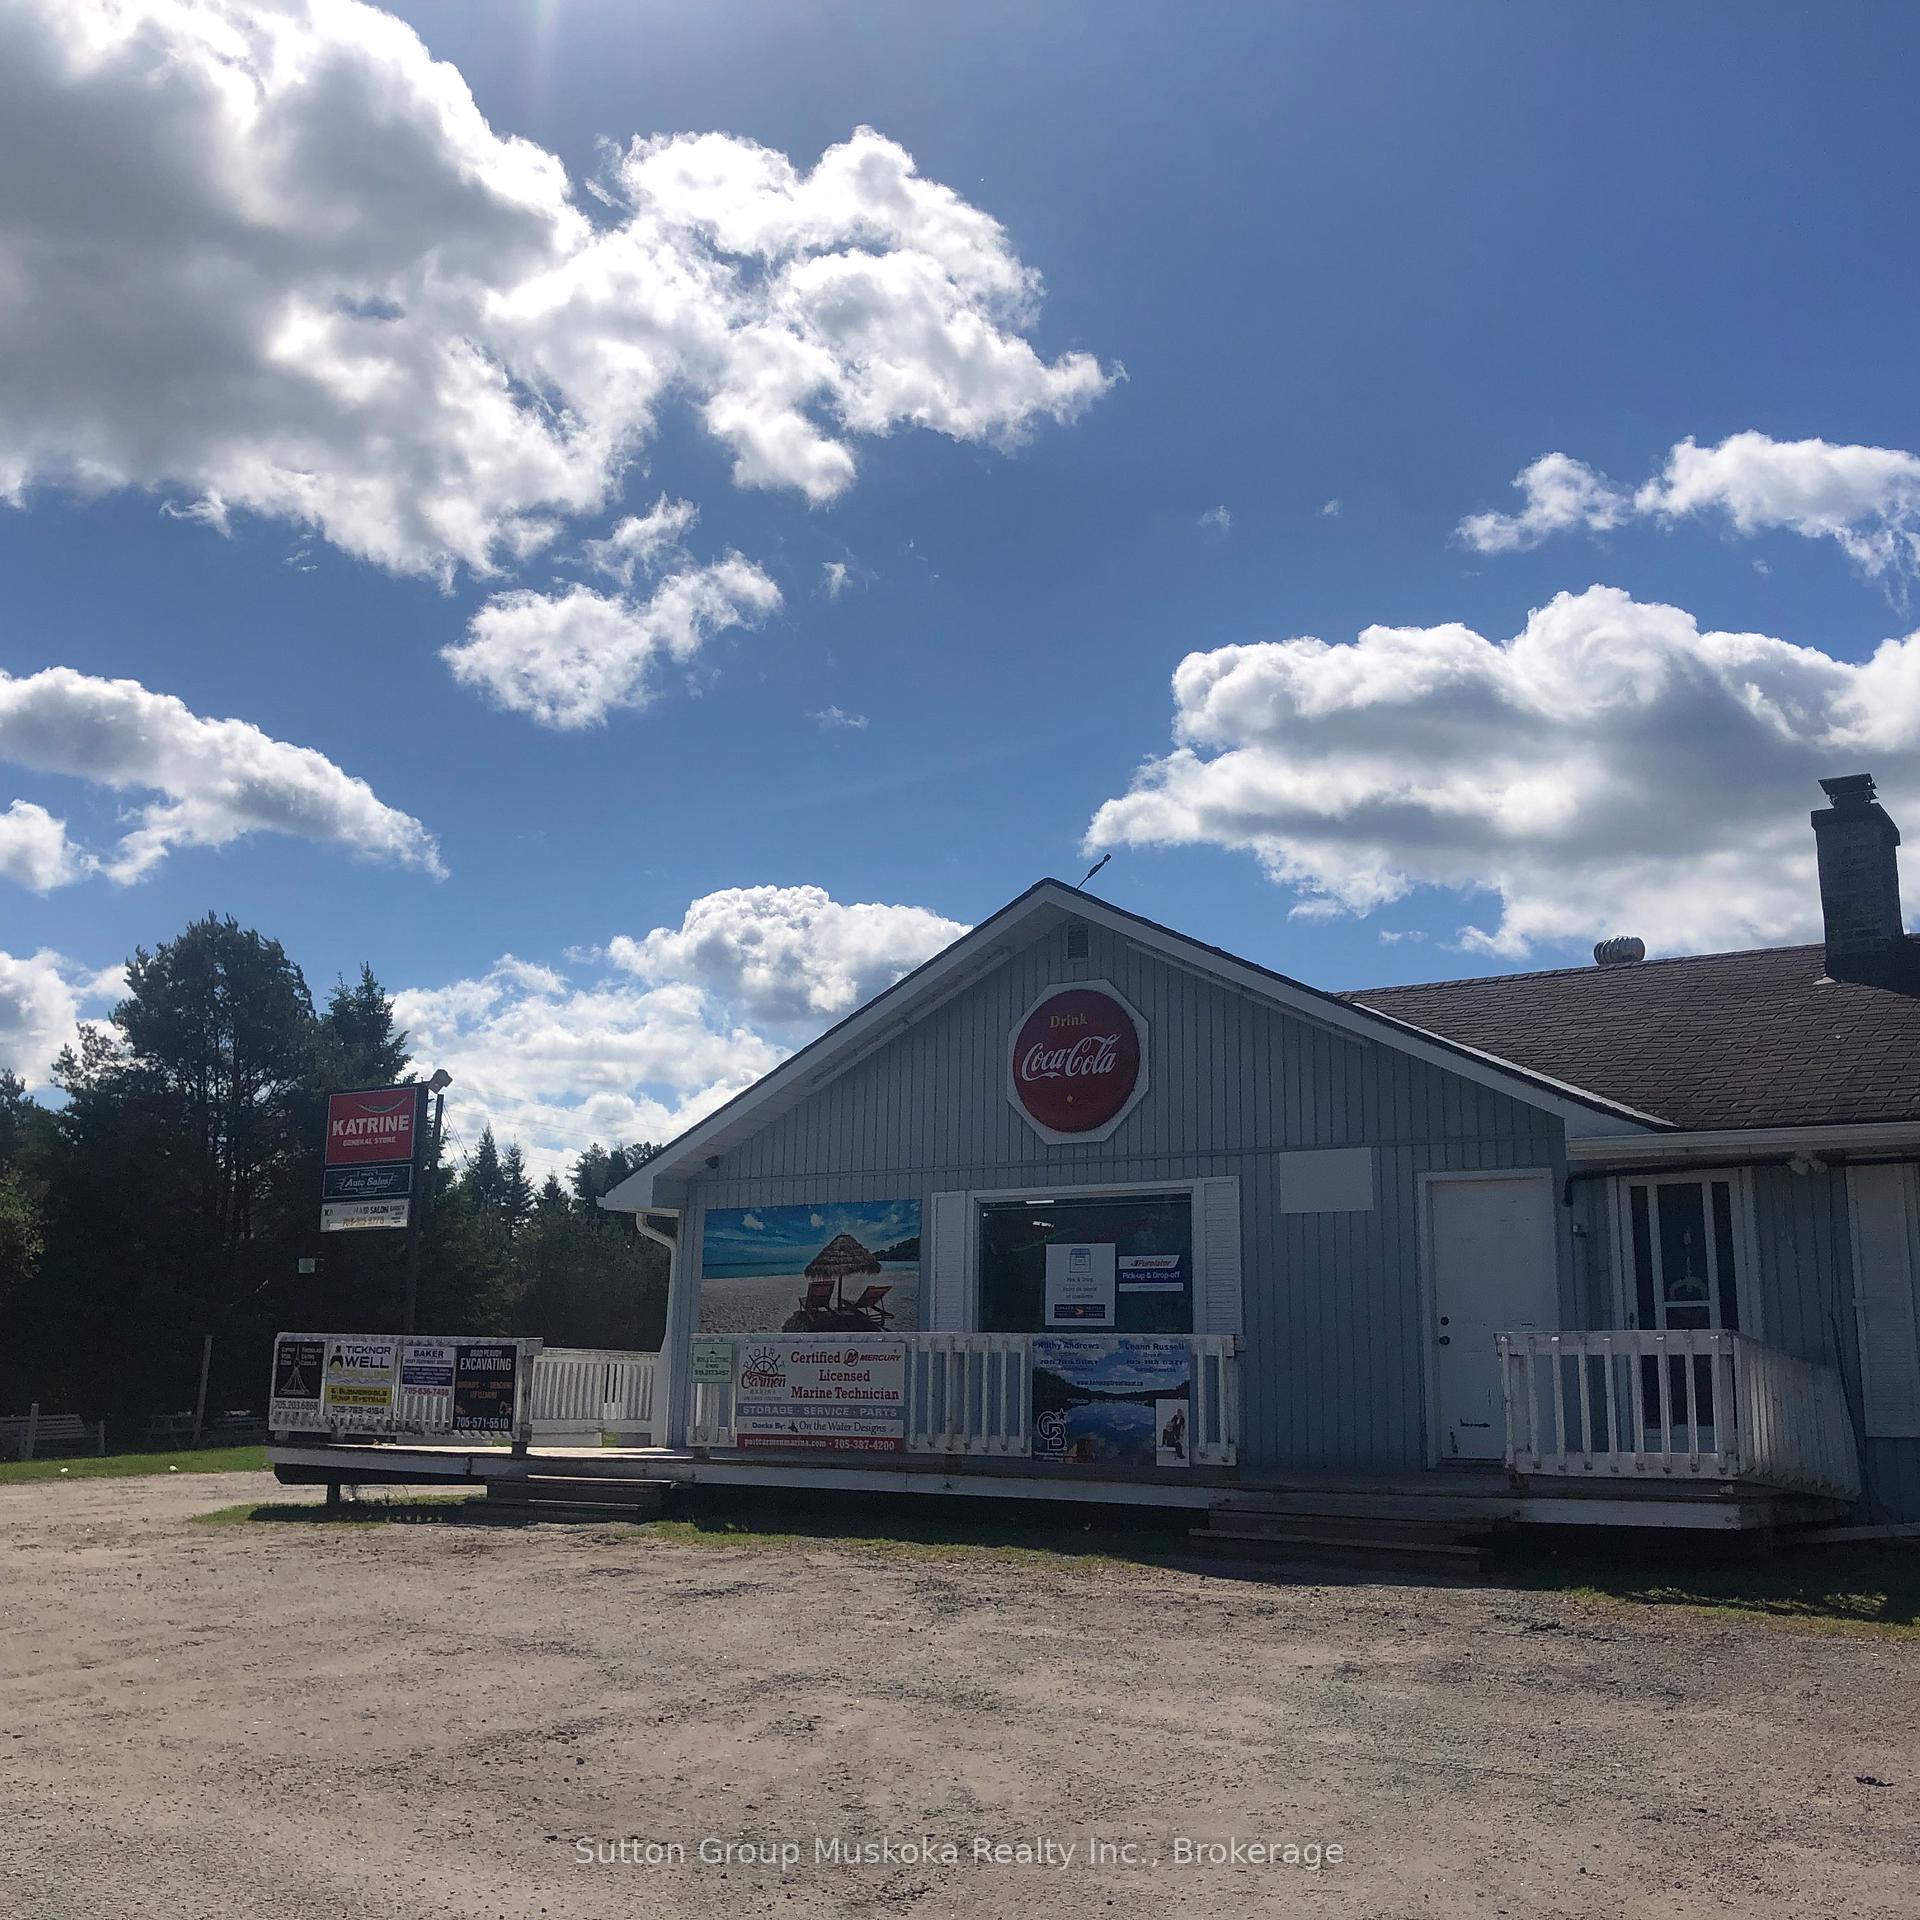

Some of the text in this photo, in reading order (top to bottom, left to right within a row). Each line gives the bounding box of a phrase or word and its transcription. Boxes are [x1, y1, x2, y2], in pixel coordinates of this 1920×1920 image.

[1050, 1013, 1088, 1028] Drink
[1022, 1034, 1121, 1081] Coca-Cola
[331, 1115, 410, 1137] KATRINE
[343, 1136, 396, 1147] GENERAL STORE
[345, 1176, 390, 1188] Auto Sales
[370, 1205, 390, 1214] SALON
[1137, 1259, 1171, 1268] Purolator
[1122, 1271, 1146, 1280] Pick-up
[1153, 1271, 1181, 1281] Drop-off
[346, 1345, 391, 1355] TICKNOR
[1063, 1342, 1100, 1350] Andrews
[1125, 1342, 1185, 1350] Leann Russell
[413, 1350, 444, 1358] BAKER
[790, 1349, 901, 1364] Certified MERCURY
[345, 1356, 389, 1369] WELL
[460, 1358, 512, 1371] EXCAVATING
[741, 1370, 787, 1389] Carmen
[818, 1369, 871, 1382] Licensed
[790, 1386, 900, 1401] Marine Technician
[743, 1406, 897, 1417] STORAGE SERVICE PARTS
[456, 1416, 509, 1429] 705-571-5510
[752, 1421, 773, 1430] Docks
[799, 1422, 812, 1430] On
[813, 1421, 826, 1431] the
[827, 1421, 853, 1432] Water
[853, 1422, 886, 1434] Designs
[834, 1438, 896, 1451] 705-387-4200
